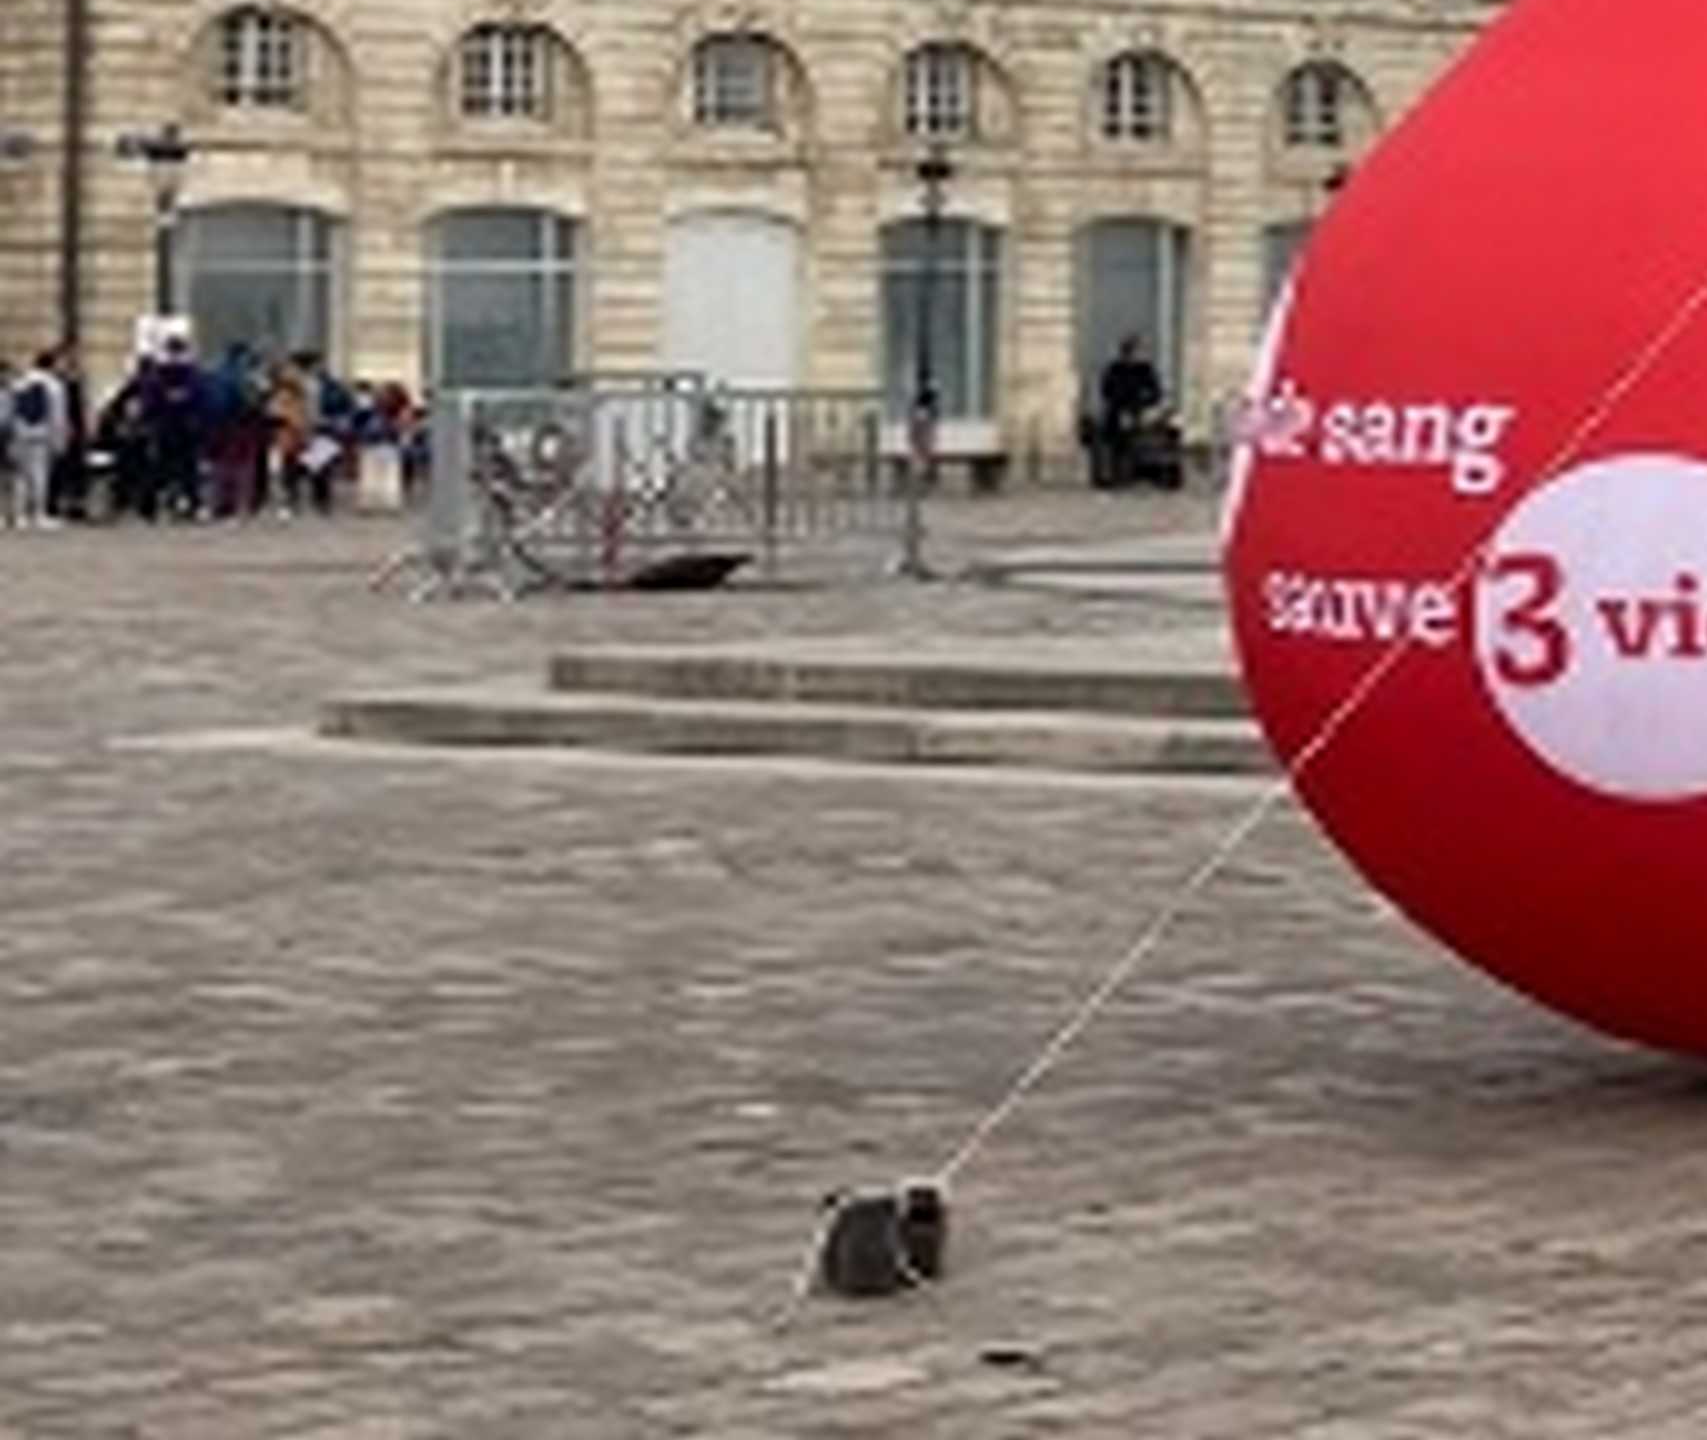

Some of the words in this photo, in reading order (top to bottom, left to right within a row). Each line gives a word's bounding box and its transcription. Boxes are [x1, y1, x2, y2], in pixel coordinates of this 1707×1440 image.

[1321, 400, 1515, 493] sang
[1264, 570, 1456, 646] sauve
[1493, 553, 1568, 687] 3
